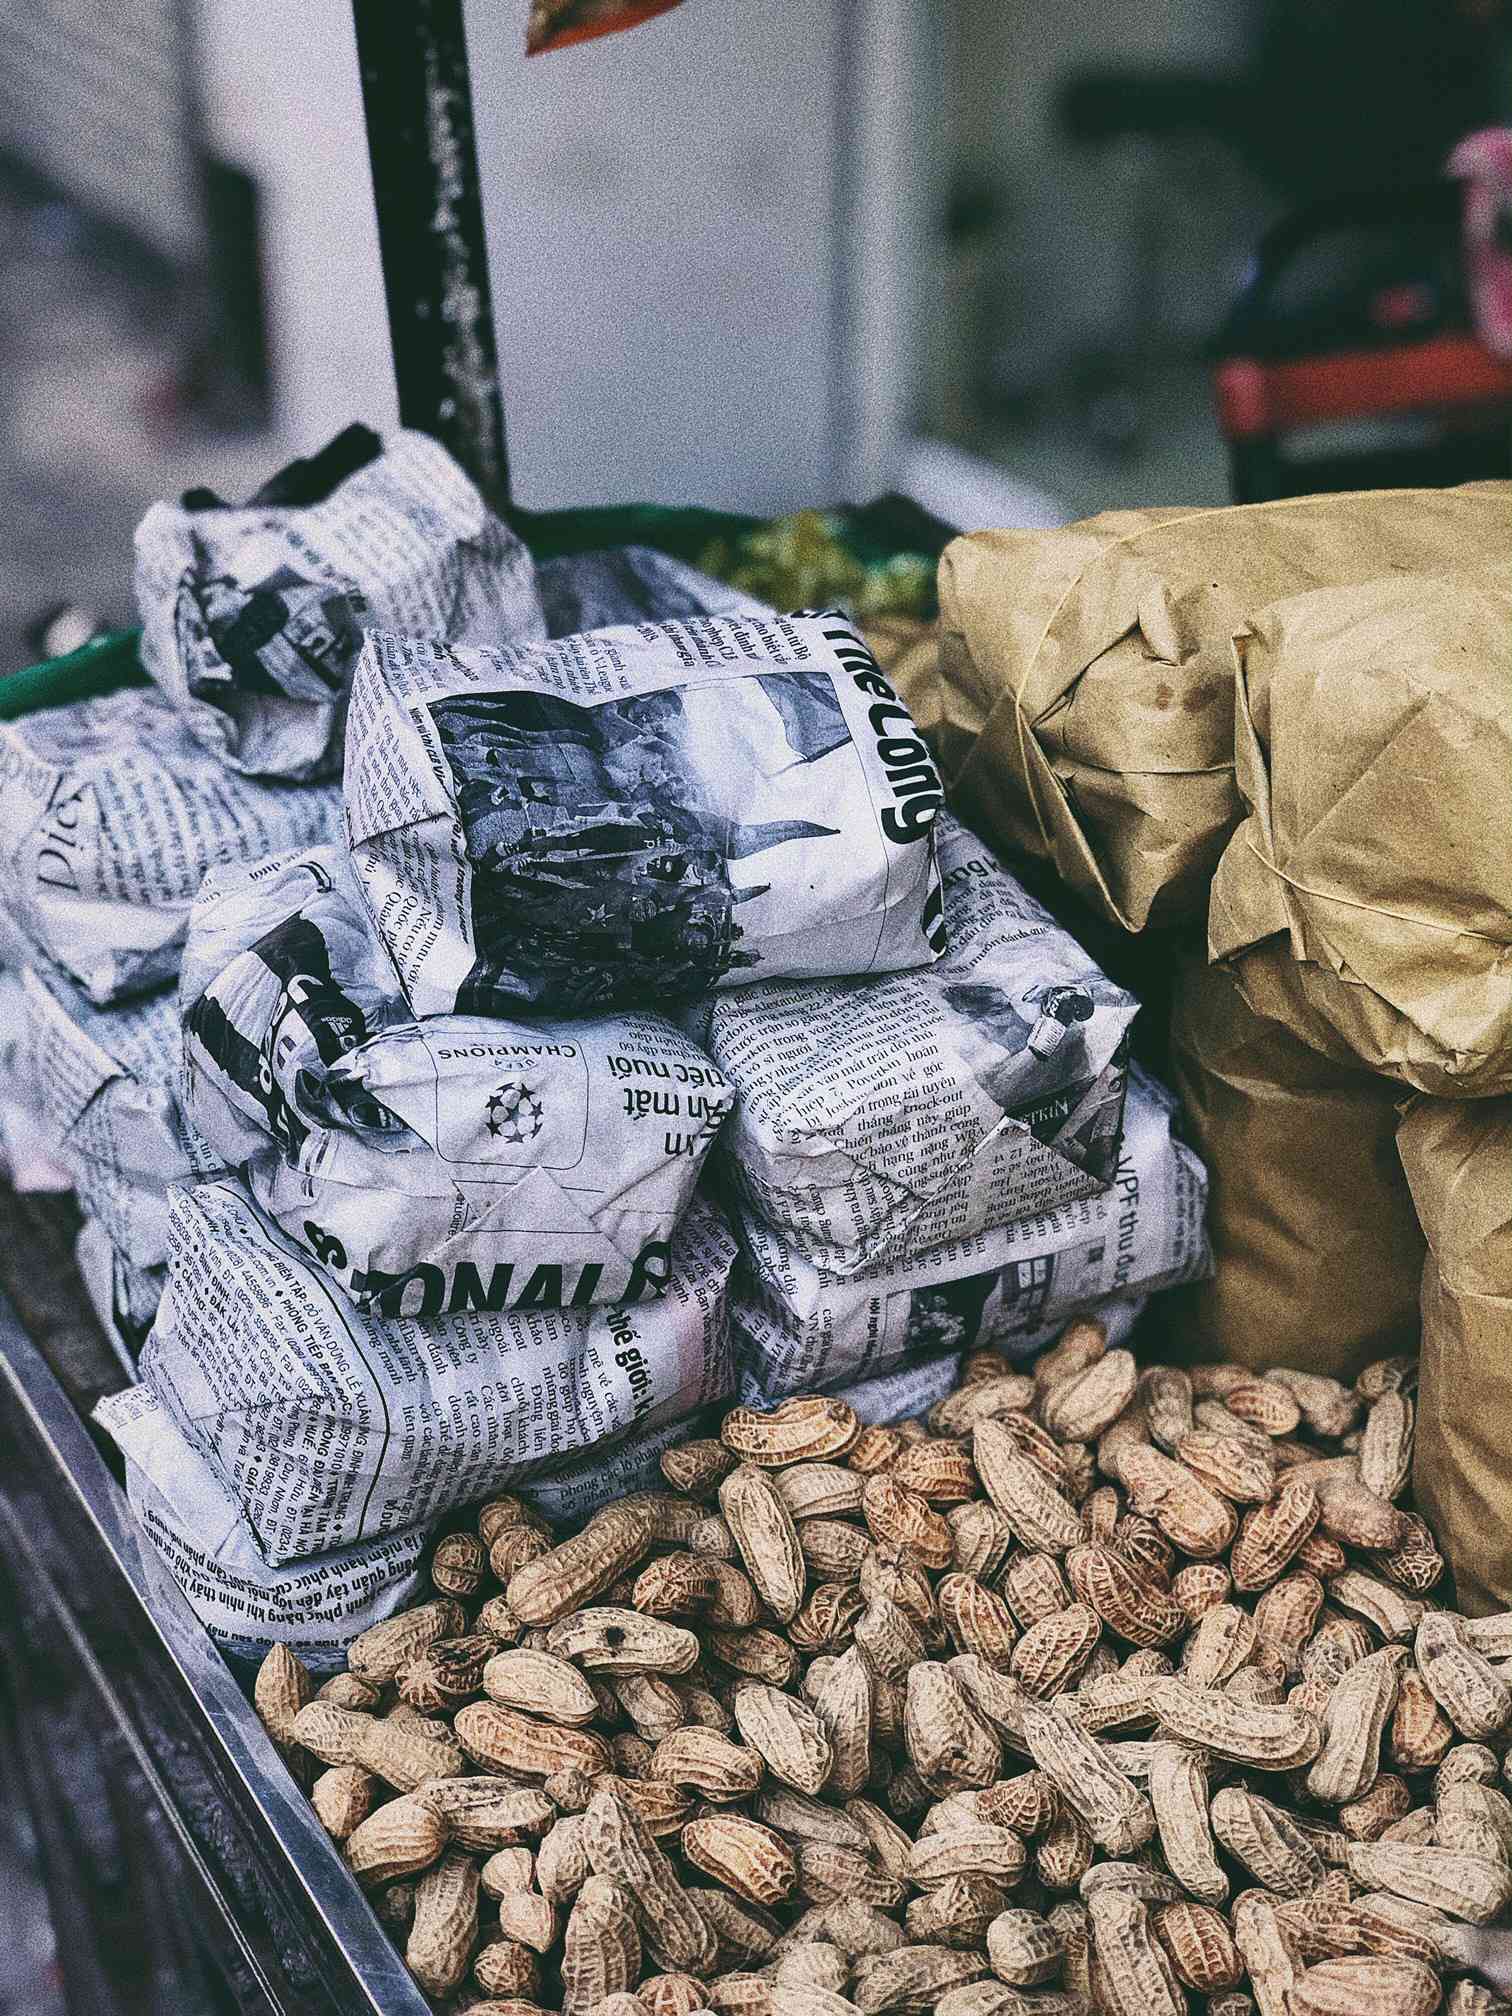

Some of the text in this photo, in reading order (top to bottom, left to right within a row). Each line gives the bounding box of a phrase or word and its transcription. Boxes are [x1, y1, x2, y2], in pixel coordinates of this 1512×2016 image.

[391, 893, 418, 932] Quốc
[409, 907, 432, 936] Nếu
[437, 1045, 575, 1058] CHAMPIONS
[723, 1031, 757, 1061] Trước
[756, 1021, 785, 1038] trận
[607, 1055, 724, 1088] tiếc nuối
[847, 1058, 901, 1089] Povetkin
[922, 1058, 945, 1079] góc
[622, 1088, 680, 1120] mất
[902, 1089, 963, 1115] knock-out
[834, 1133, 873, 1151] Chiến
[915, 1112, 940, 1126] này
[943, 1104, 972, 1121] giúp
[910, 1122, 947, 1142] thành
[949, 1116, 981, 1133] công
[882, 1149, 915, 1168] hạng
[896, 1161, 929, 1179] cũng
[1114, 1156, 1138, 1205] VPF
[279, 1297, 310, 1334] PHÒNG
[301, 1332, 327, 1361] TIẾP
[287, 1279, 311, 1304] TẬP:
[312, 1316, 334, 1341] VĂN
[325, 1338, 353, 1375] DŨNG,
[344, 1373, 362, 1391] LÊ
[506, 1314, 527, 1351] Great
[542, 1314, 558, 1341] làm
[605, 1310, 641, 1345] thế
[378, 1351, 402, 1385] mạnh
[426, 1343, 448, 1375] đánh
[445, 1342, 460, 1369] viên.
[465, 1353, 478, 1365] ty
[539, 1365, 560, 1410] những
[614, 1347, 655, 1399] giới:
[448, 1394, 467, 1438] doanh
[480, 1385, 500, 1449] Các nhân
[602, 1391, 621, 1413] các
[401, 1405, 417, 1432] liên
[418, 1403, 434, 1447] với các
[467, 1414, 481, 1437] cao
[517, 1417, 530, 1454] khách
[401, 1533, 419, 1553] là
[293, 1565, 328, 1591] phúc
[329, 1553, 368, 1579] hạnh
[215, 1589, 247, 1614] nhìn
[323, 1580, 350, 1602] tây
[242, 1601, 269, 1622] khi
